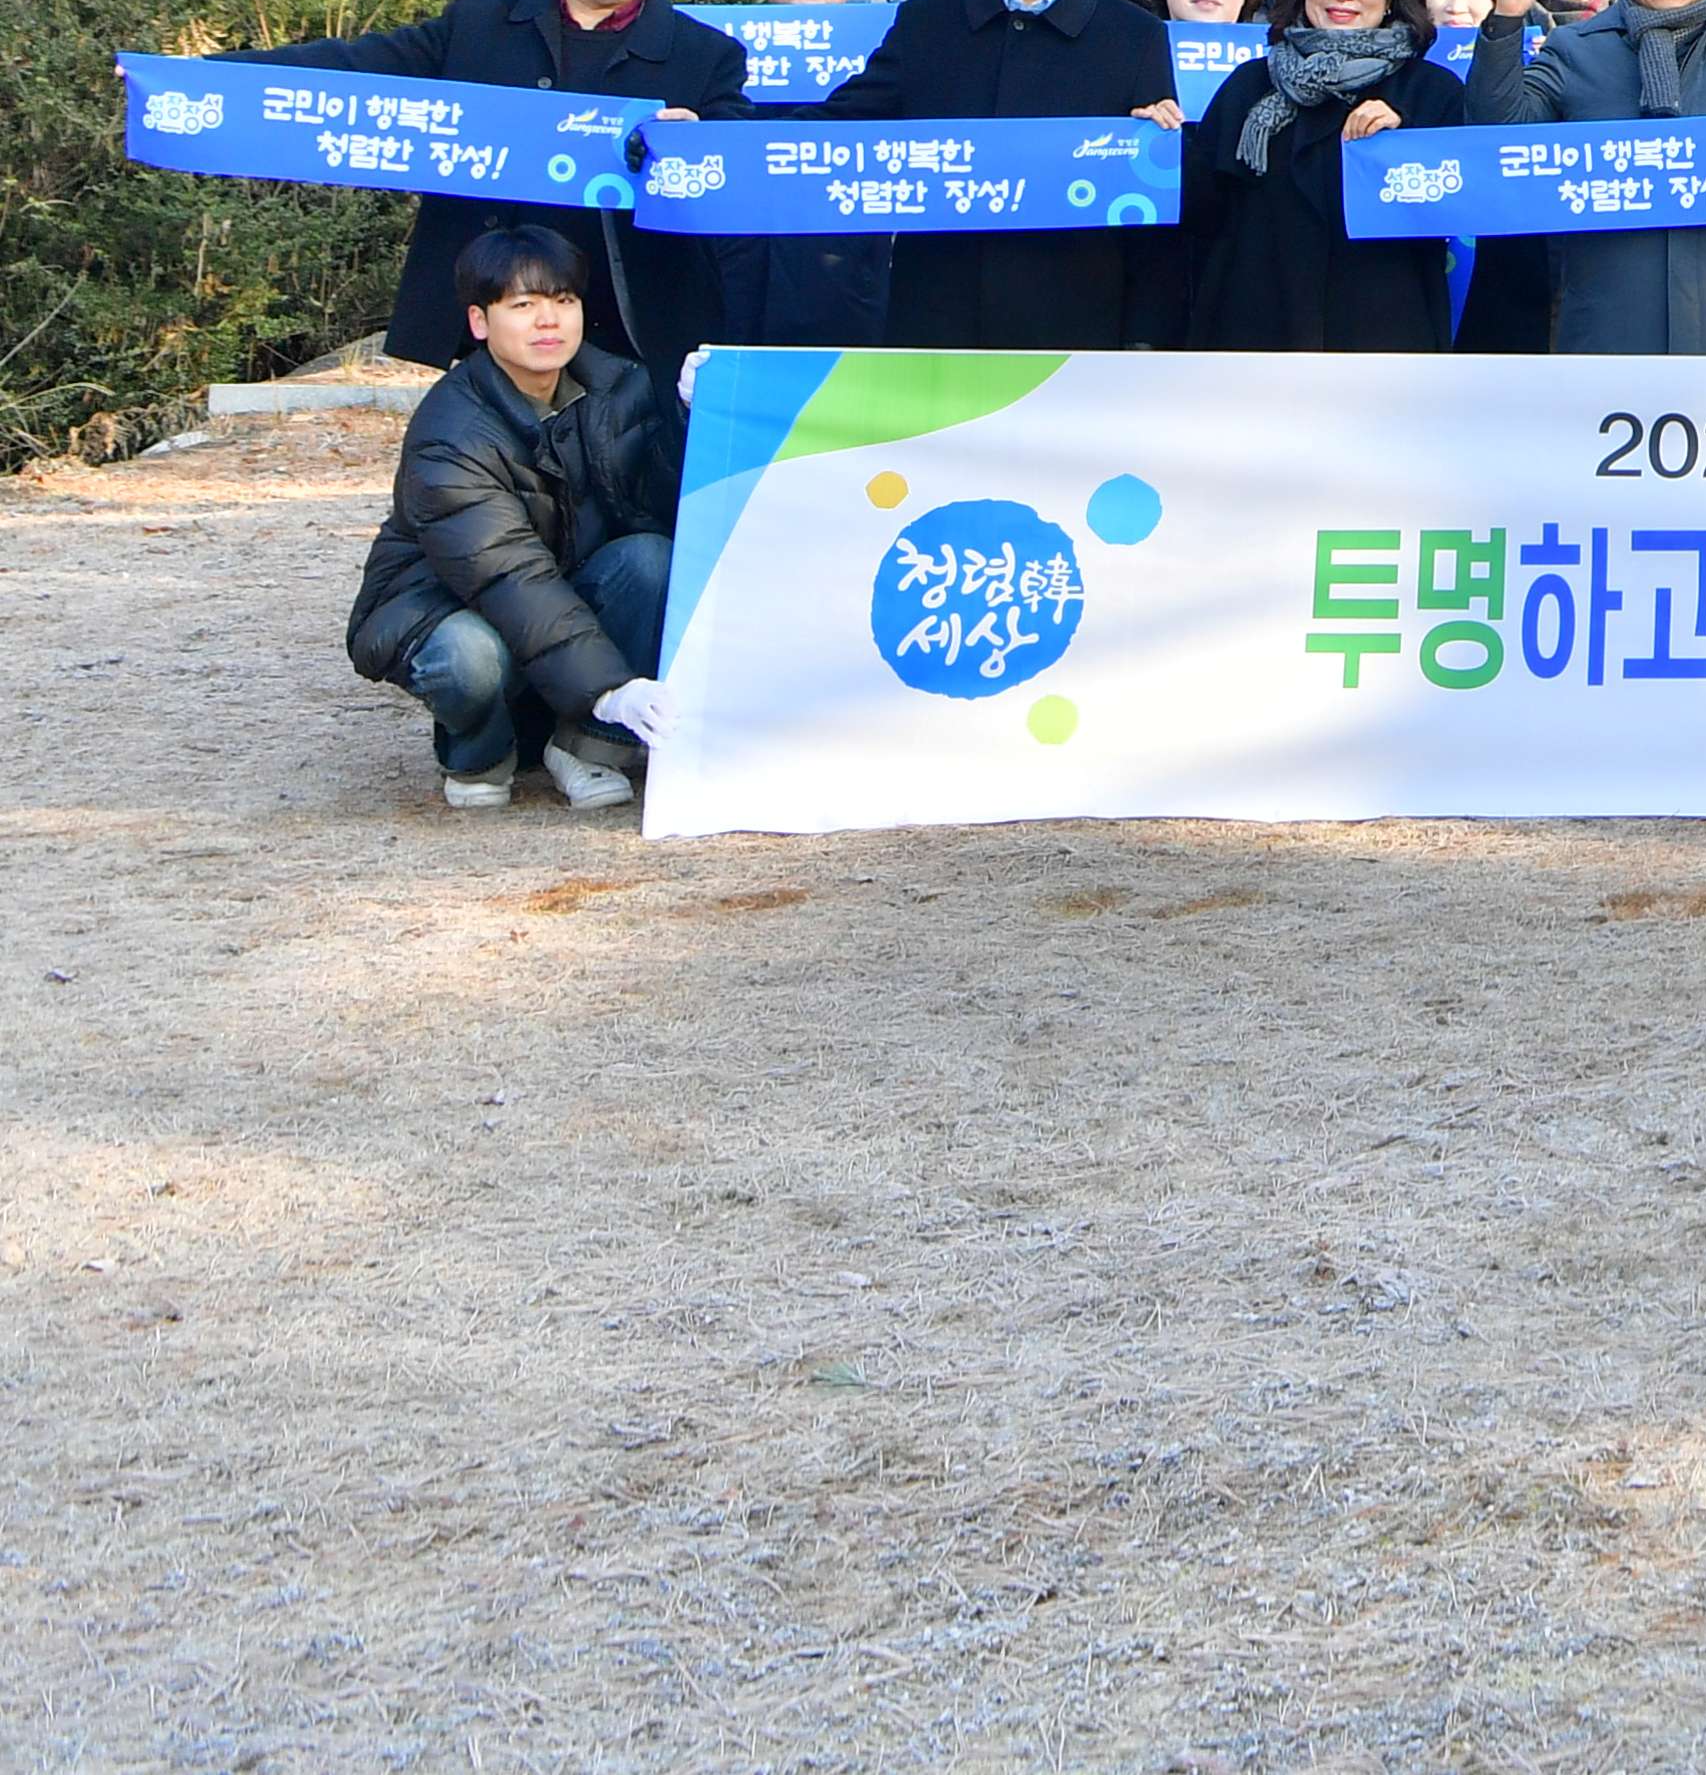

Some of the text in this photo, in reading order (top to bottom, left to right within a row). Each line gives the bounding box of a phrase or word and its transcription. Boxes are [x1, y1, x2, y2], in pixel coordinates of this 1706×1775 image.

[740, 19, 833, 51] 행복한
[745, 55, 791, 86] 렴한
[263, 87, 463, 136] 군민이 행복한
[317, 131, 509, 180] 청렴한 장성!
[765, 138, 975, 174] 군민이 행복한
[1500, 135, 1697, 178] 군민이 행복한
[826, 178, 1026, 214] 청렴한 장성!
[1558, 178, 1654, 213] 청렴한
[896, 605, 1040, 678] 세상
